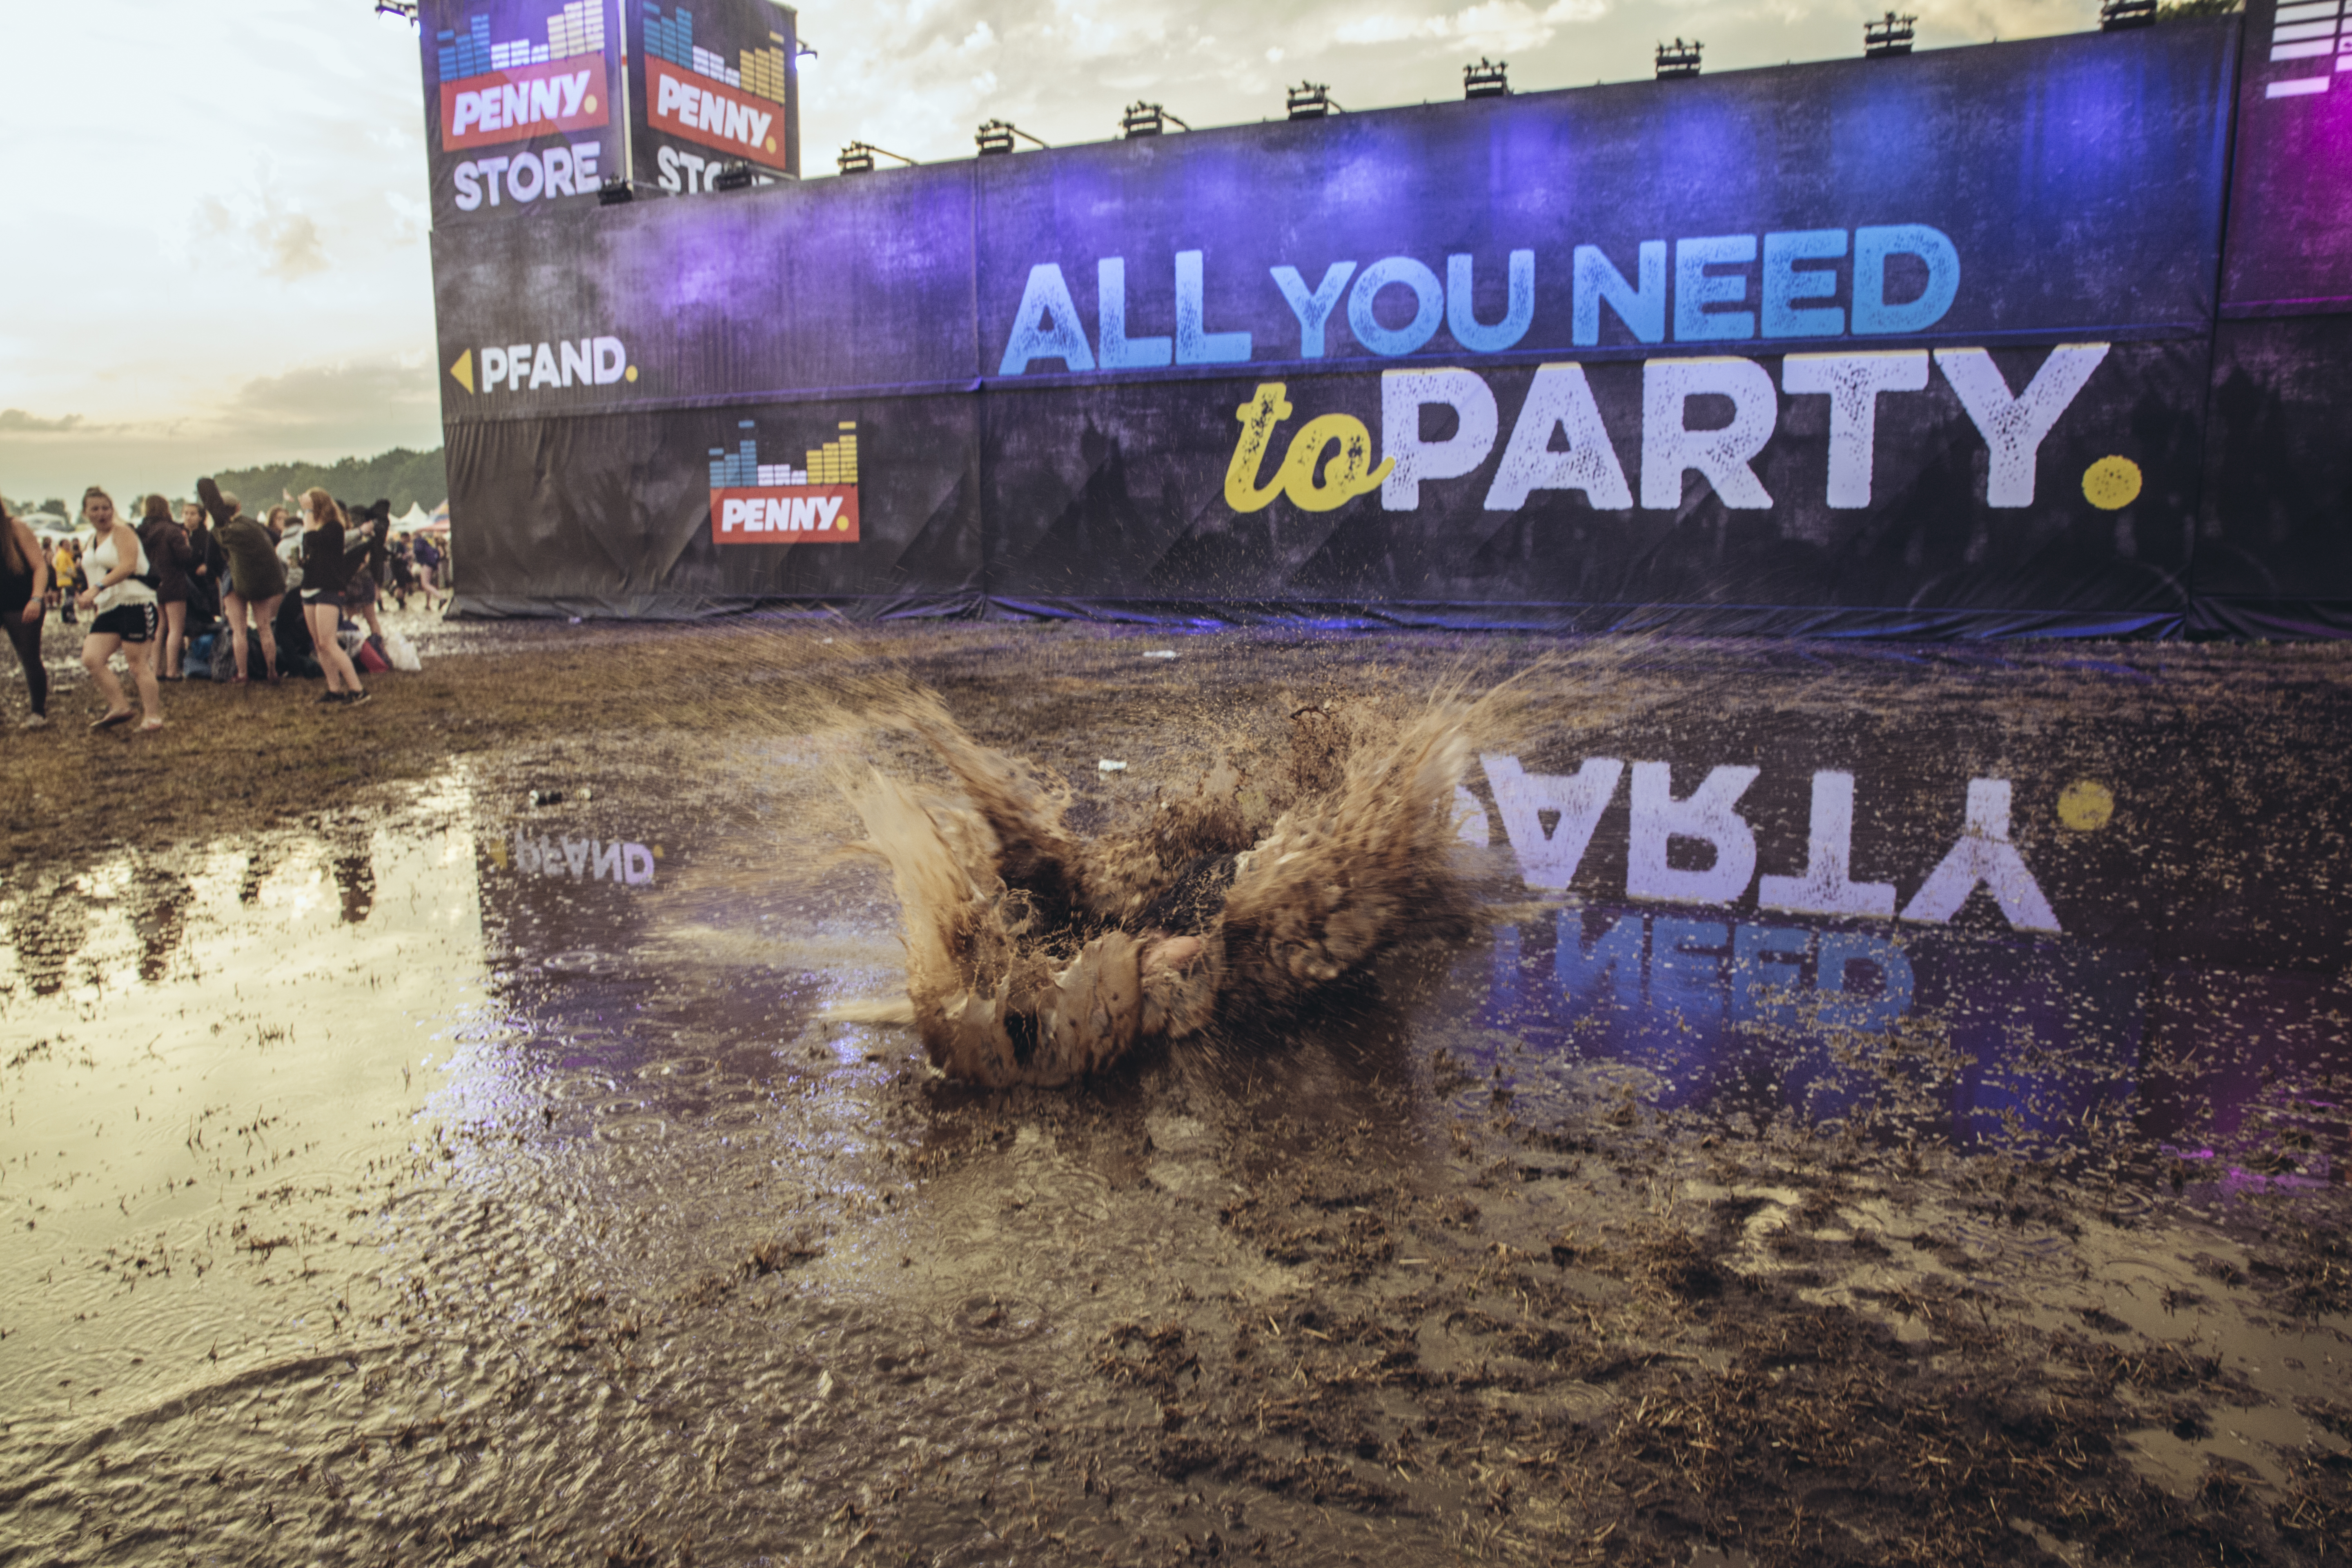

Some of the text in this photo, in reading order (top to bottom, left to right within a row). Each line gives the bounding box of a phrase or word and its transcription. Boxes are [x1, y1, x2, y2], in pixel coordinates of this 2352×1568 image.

[454, 141, 600, 211] STORE
[998, 223, 1960, 375] ALL YOU NEED
[481, 336, 638, 392] PFAND.
[1225, 342, 2143, 513] to PARTY.
